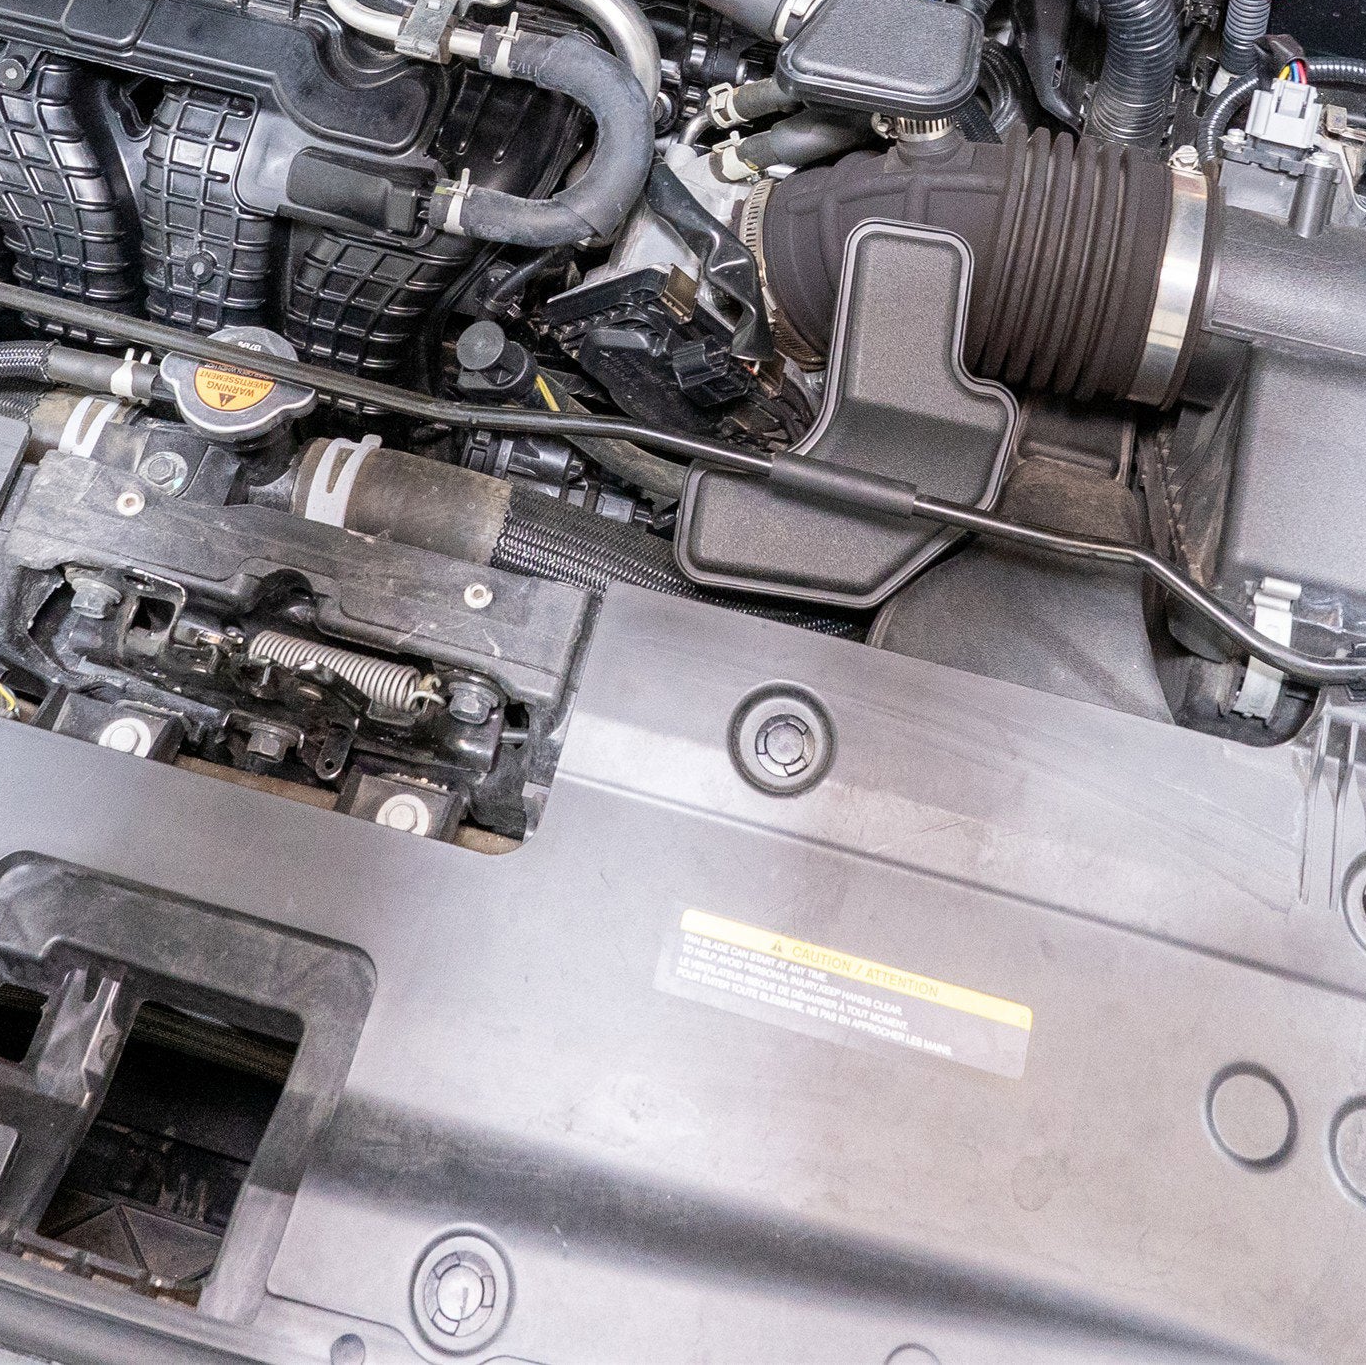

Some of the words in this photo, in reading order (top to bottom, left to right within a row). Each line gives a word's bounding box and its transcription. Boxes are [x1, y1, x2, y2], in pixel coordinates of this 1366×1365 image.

[198, 370, 270, 390] AVERTISSEMENT
[206, 380, 255, 398] WARNING
[680, 944, 694, 955] TO
[693, 947, 718, 962] HELP
[716, 954, 744, 970] AVOID
[743, 962, 790, 983] PERSONAL
[841, 990, 872, 1006] HANDS
[700, 937, 730, 954] BLADE
[728, 946, 749, 959] CAN
[748, 951, 777, 967] START
[775, 959, 788, 970] AT
[787, 963, 806, 976] ANY
[790, 945, 851, 972] CAUTION
[864, 966, 939, 998] ATTENTION
[674, 966, 702, 982] POUR
[700, 972, 731, 991] ÉVITER
[730, 982, 759, 999] TOUTE
[804, 1004, 819, 1016] NE
[818, 1008, 838, 1022] PAS
[837, 1014, 851, 1026] EN
[850, 1017, 906, 1042] APPROCHER
[905, 1033, 923, 1047] LES
[678, 955, 690, 967] LE
[688, 958, 745, 983] VENTILATEUR
[743, 974, 778, 992] RISQUE
[776, 984, 790, 996] DE
[838, 1000, 846, 1012] À
[845, 1004, 869, 1019] TOUT
